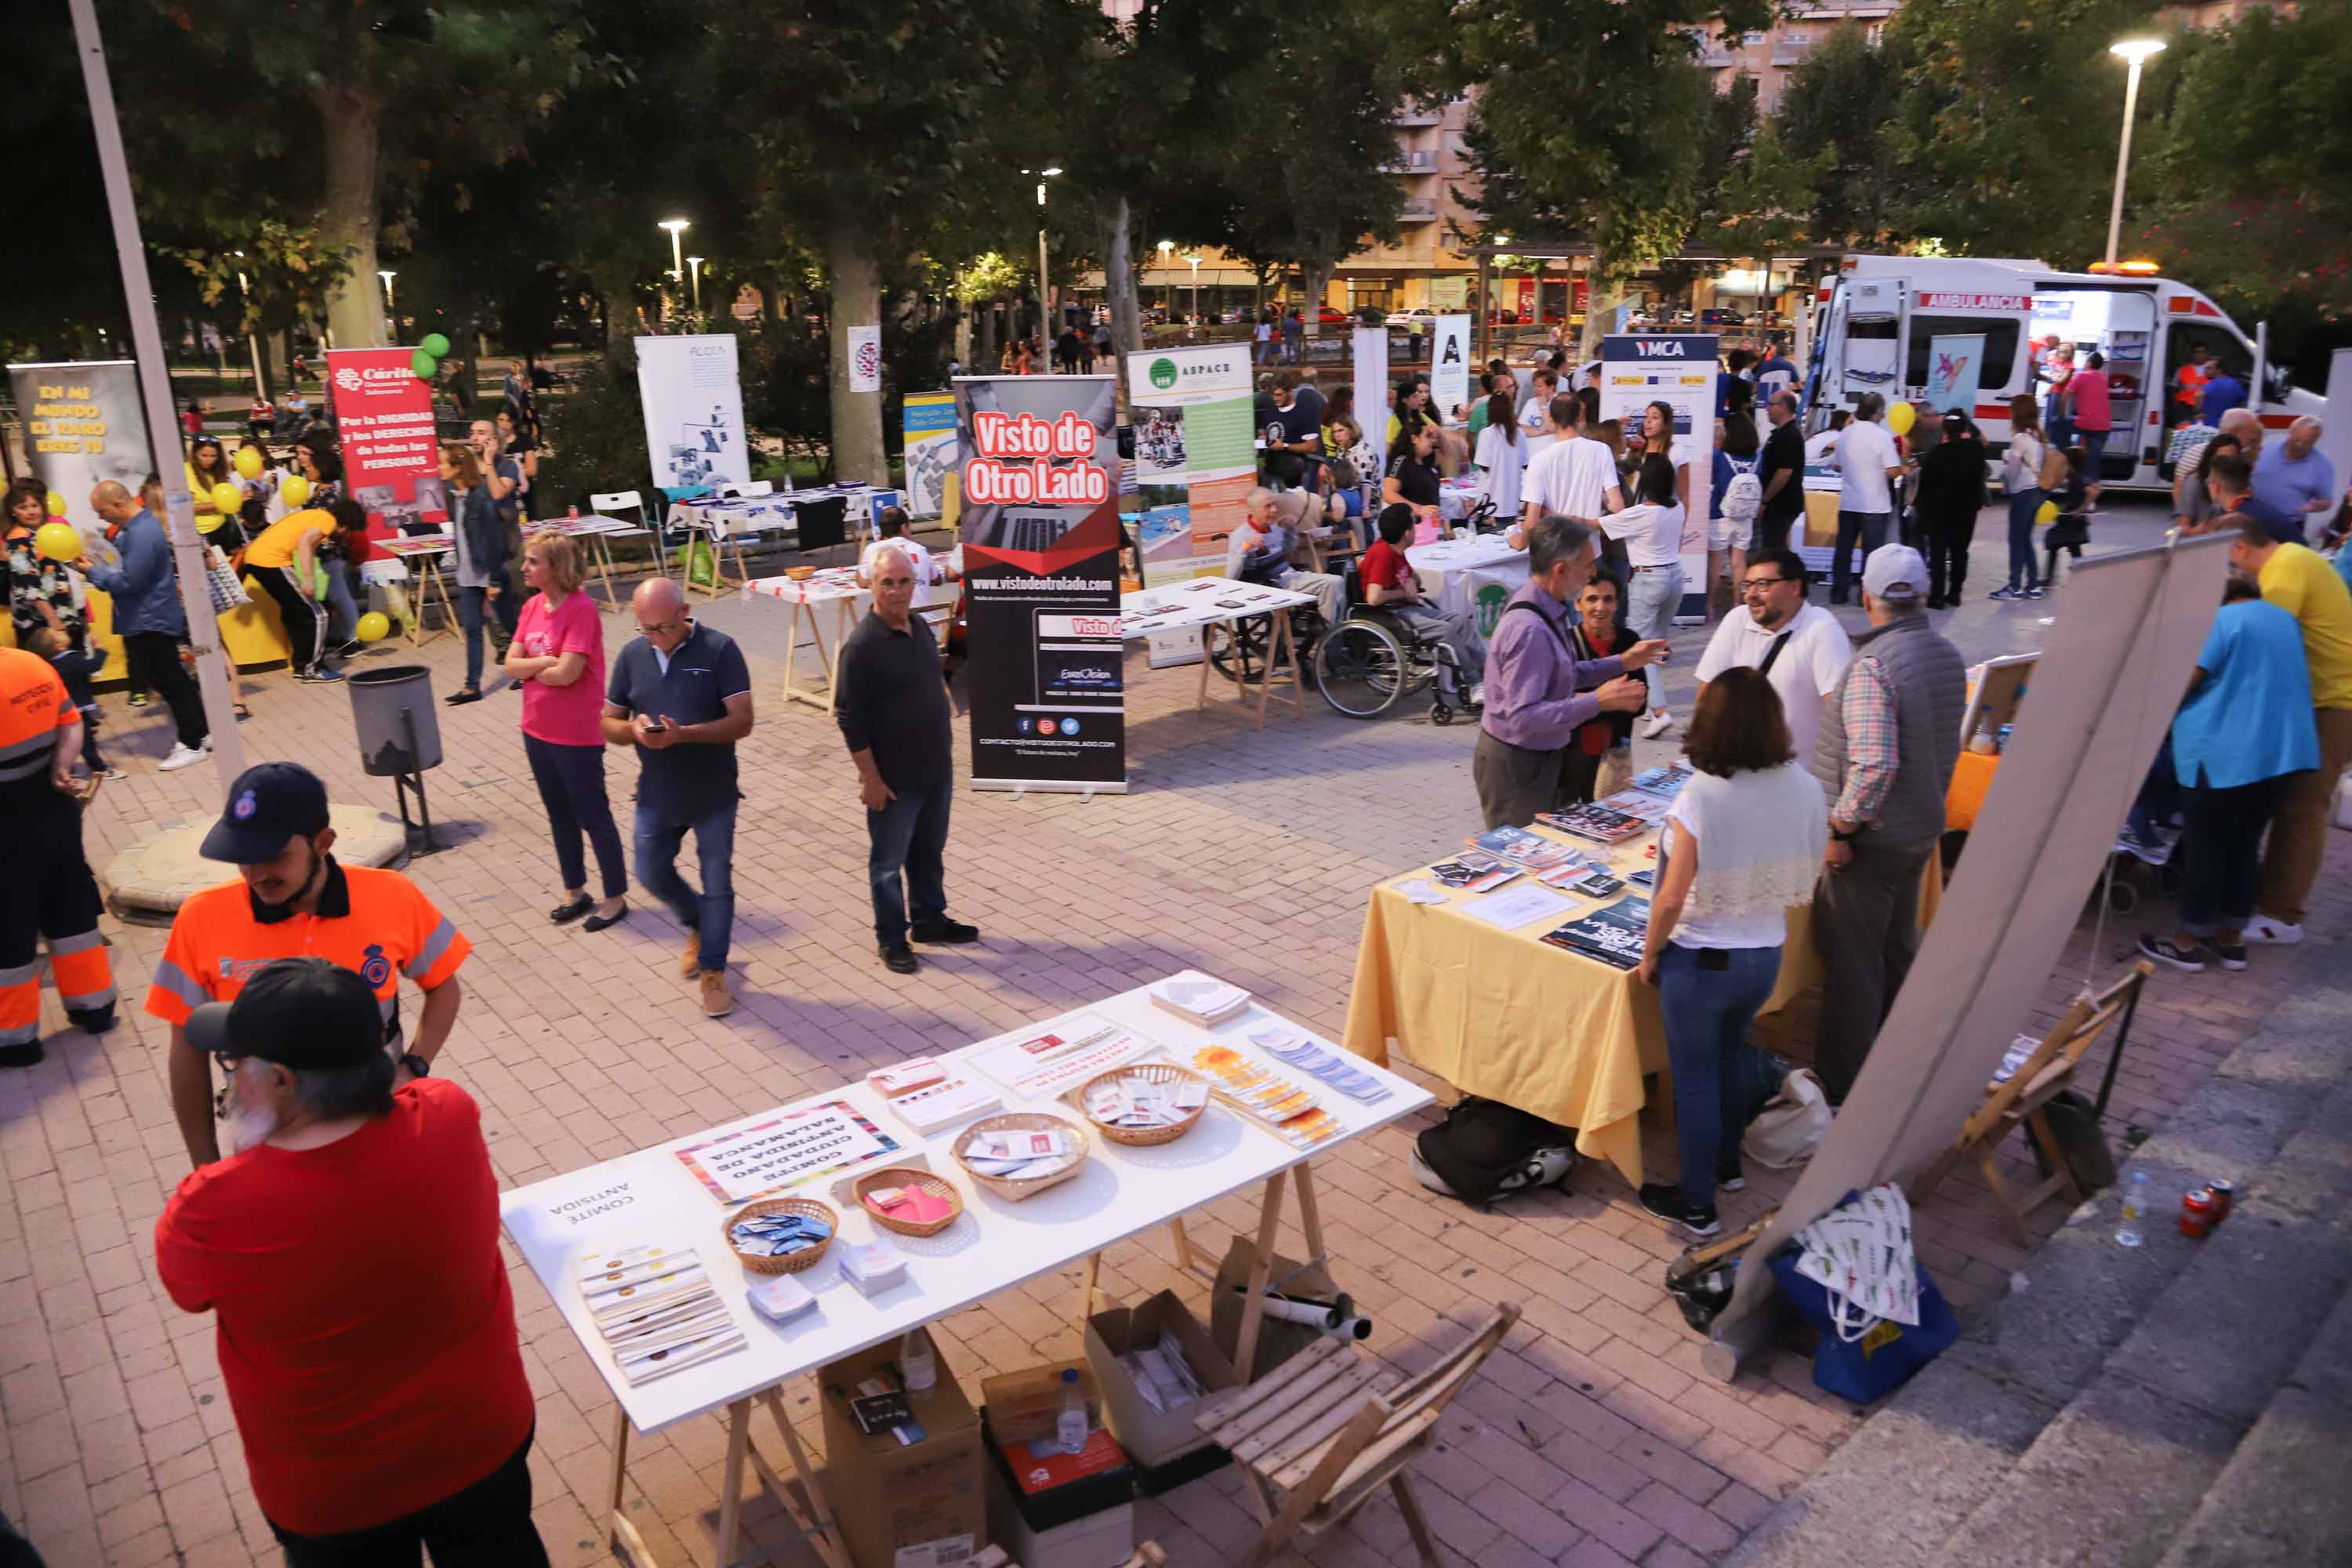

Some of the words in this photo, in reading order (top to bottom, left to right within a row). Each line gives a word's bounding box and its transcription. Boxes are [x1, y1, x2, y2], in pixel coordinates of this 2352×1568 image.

[1928, 294, 2025, 310] AMBULANCIA
[1635, 340, 1686, 357] YMCA
[362, 367, 417, 380] Cárita
[1181, 363, 1231, 376] ASPACE
[37, 385, 64, 400] EN
[33, 401, 100, 419] MUNDO
[29, 420, 51, 435] EL
[339, 416, 362, 427] Por
[363, 415, 376, 425] la
[376, 412, 435, 424] DIGNIDAD
[342, 433, 352, 444] y
[352, 431, 372, 441] los
[372, 426, 436, 439] DERECHOS
[977, 415, 1051, 454] Visto
[1056, 415, 1093, 454] de
[35, 438, 81, 453] ERES
[356, 445, 373, 455] de
[373, 443, 408, 454] todas
[408, 441, 429, 452] las
[361, 456, 427, 470] PERSONAS
[969, 462, 1033, 501] Otro
[1036, 462, 1105, 501] Lado
[971, 575, 1113, 591] www.vistodeotrolado.com
[1071, 617, 1109, 635] Visto
[709, 1116, 837, 1161] SALAMANCA
[750, 1123, 846, 1160] ANTISIDA
[732, 1134, 853, 1178] CIUDADANO
[717, 1159, 747, 1172] DE
[762, 1150, 844, 1181] COMITE
[549, 1182, 629, 1214] ANTISIDA
